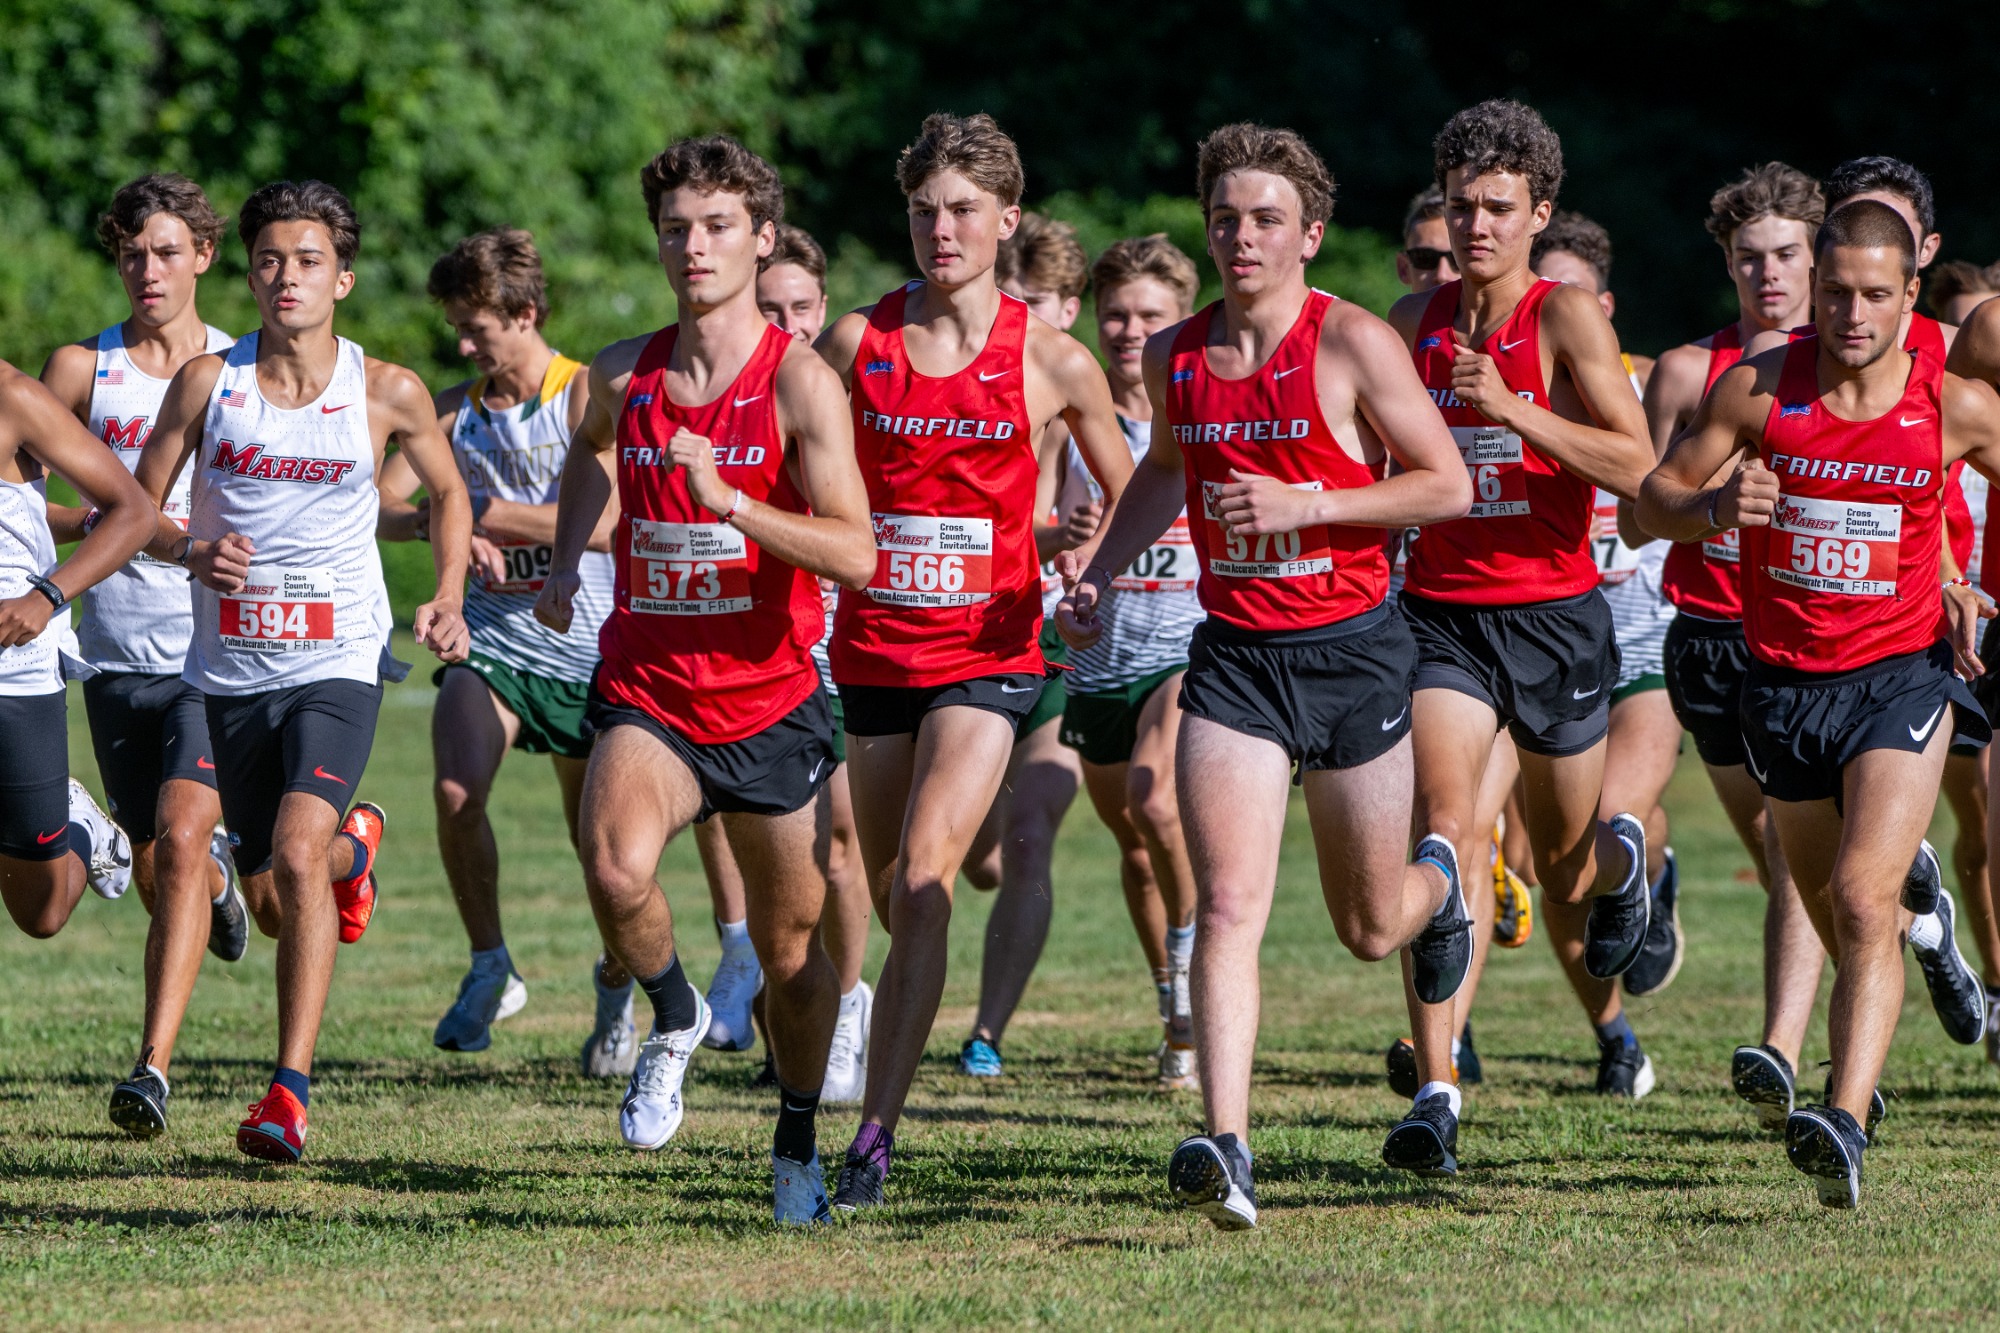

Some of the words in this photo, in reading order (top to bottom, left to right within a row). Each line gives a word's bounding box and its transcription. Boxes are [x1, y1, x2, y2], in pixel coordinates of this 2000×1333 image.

[863, 410, 1015, 440] FAIRFIELD
[1171, 419, 1310, 444] FAIRFIELD
[1473, 433, 1495, 441] Cross
[1473, 442, 1504, 451] Country
[1474, 450, 1519, 459] Invitational
[210, 438, 356, 485] MARIST
[1770, 452, 1932, 488] FAIRFIELD
[1846, 508, 1872, 518] Cross
[1781, 510, 1840, 531] MARIST
[1845, 517, 1880, 528] Country
[939, 523, 964, 532] Cross
[1845, 527, 1896, 537] Invitational
[689, 530, 713, 538] Cross
[880, 530, 934, 547] MARIST
[939, 532, 973, 542] Country
[637, 537, 685, 554] MARIST
[690, 540, 723, 549] Country
[939, 542, 989, 551] Invitational
[691, 546, 741, 556] Invitational
[1791, 535, 1870, 579] 569
[1120, 547, 1177, 578] 02
[889, 552, 965, 593] 566
[1214, 562, 1231, 573] Fulton
[1231, 563, 1258, 574] Accurate
[1258, 564, 1280, 576] Timing
[284, 573, 307, 581] Cross
[647, 561, 721, 599] 573
[1774, 569, 1793, 582] Fulton
[1793, 573, 1821, 588] Accurate
[1822, 579, 1845, 592] Timing
[242, 585, 279, 596] ARIST
[284, 582, 315, 591] Country
[284, 590, 331, 598] Invitational
[873, 590, 892, 601] Fulton
[892, 592, 919, 603] Accurate
[920, 594, 942, 605] Timing
[652, 601, 679, 611] Accurate
[680, 602, 701, 613] Timing
[238, 602, 309, 638] 594
[224, 637, 241, 647] Fulton
[241, 638, 266, 649] Accurate
[267, 641, 287, 651] Timing
